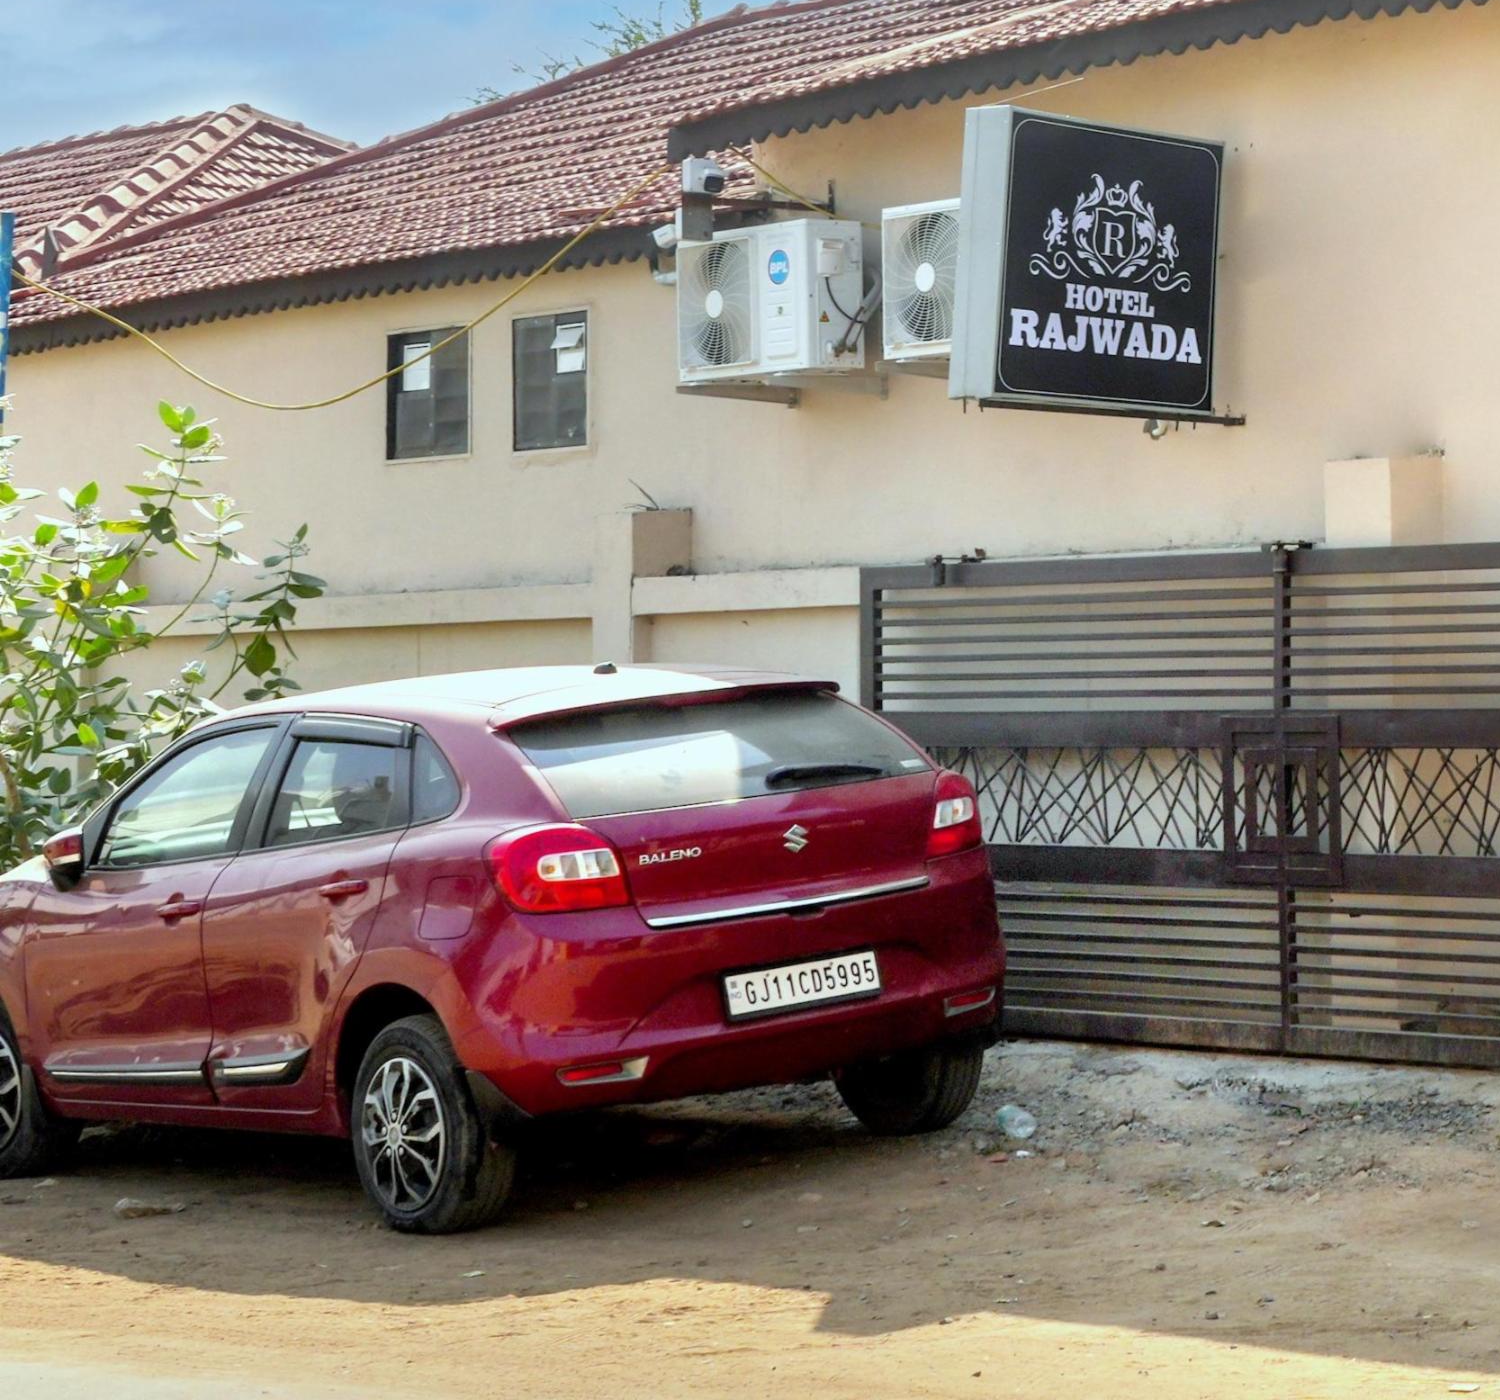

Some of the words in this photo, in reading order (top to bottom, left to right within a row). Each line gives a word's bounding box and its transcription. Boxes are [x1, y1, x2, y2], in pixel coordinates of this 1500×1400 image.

[1100, 221, 1126, 258] R
[769, 261, 789, 274] BPL
[1064, 283, 1155, 318] HOTEL
[1008, 308, 1202, 364] RAJWADA
[639, 846, 702, 866] BALENO
[745, 959, 875, 1005] GJ11CD5995
